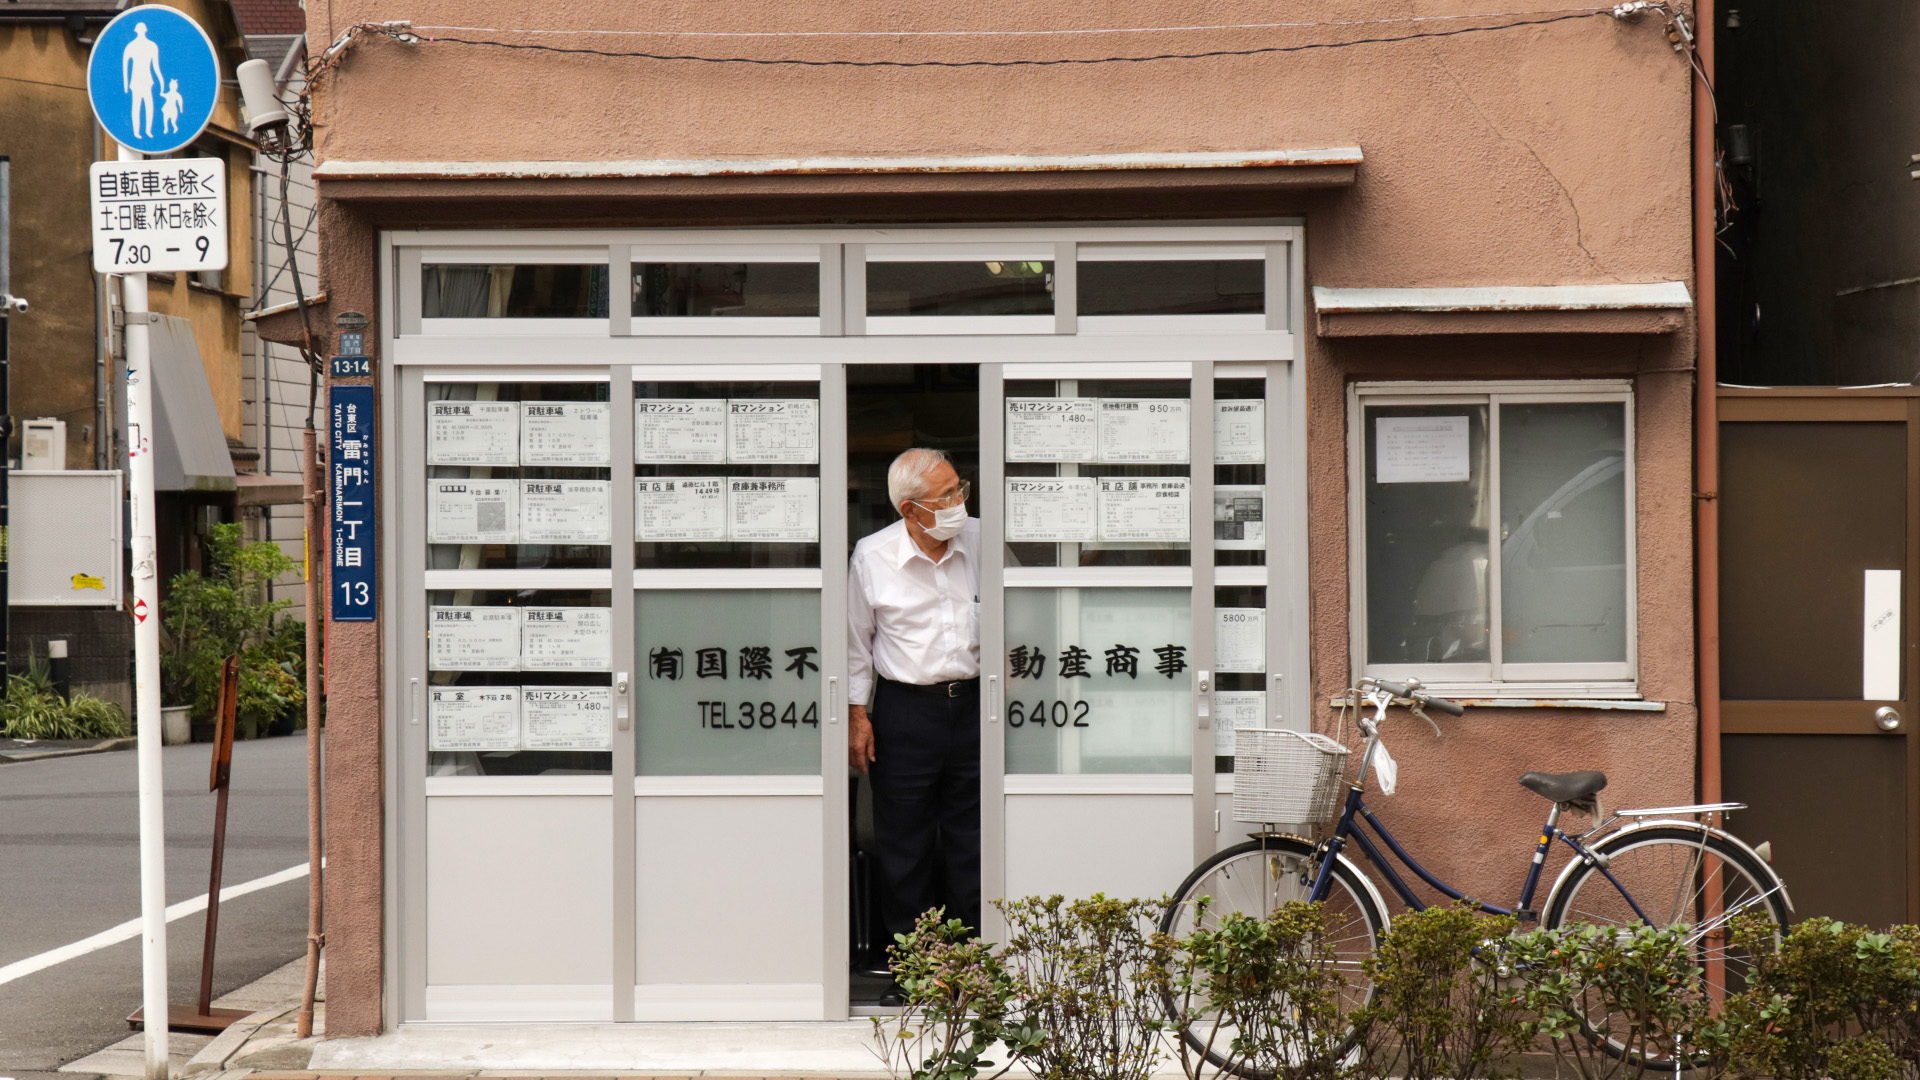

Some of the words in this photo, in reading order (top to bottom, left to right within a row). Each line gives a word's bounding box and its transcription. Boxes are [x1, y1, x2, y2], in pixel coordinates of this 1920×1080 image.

[100, 168, 214, 198] 自転車を除く
[109, 238, 151, 264] 7.30
[195, 236, 210, 262] 9
[334, 360, 370, 373] 13-14
[435, 406, 470, 415] 貸駐車場
[528, 406, 564, 416] 貸駐車場
[640, 404, 694, 413] 貸マンション
[731, 404, 785, 413] 貸マンション
[1010, 403, 1073, 412] 売りマンション
[346, 403, 357, 433] 台東区
[527, 484, 562, 493] 貸駐車場
[639, 482, 675, 492] 貸店舗
[732, 482, 785, 491] 倉庫兼事務所
[1011, 483, 1063, 491] 貸マンション
[1102, 482, 1138, 491] 貸店舗
[343, 440, 363, 567] 雷門一丁目
[341, 582, 369, 606] 13
[436, 611, 472, 620] 貸駐車場
[528, 612, 563, 621] 貸駐車場
[1008, 644, 1188, 680] 動産商事
[525, 692, 588, 700] 売りマンション
[1008, 700, 1090, 728] 6402
